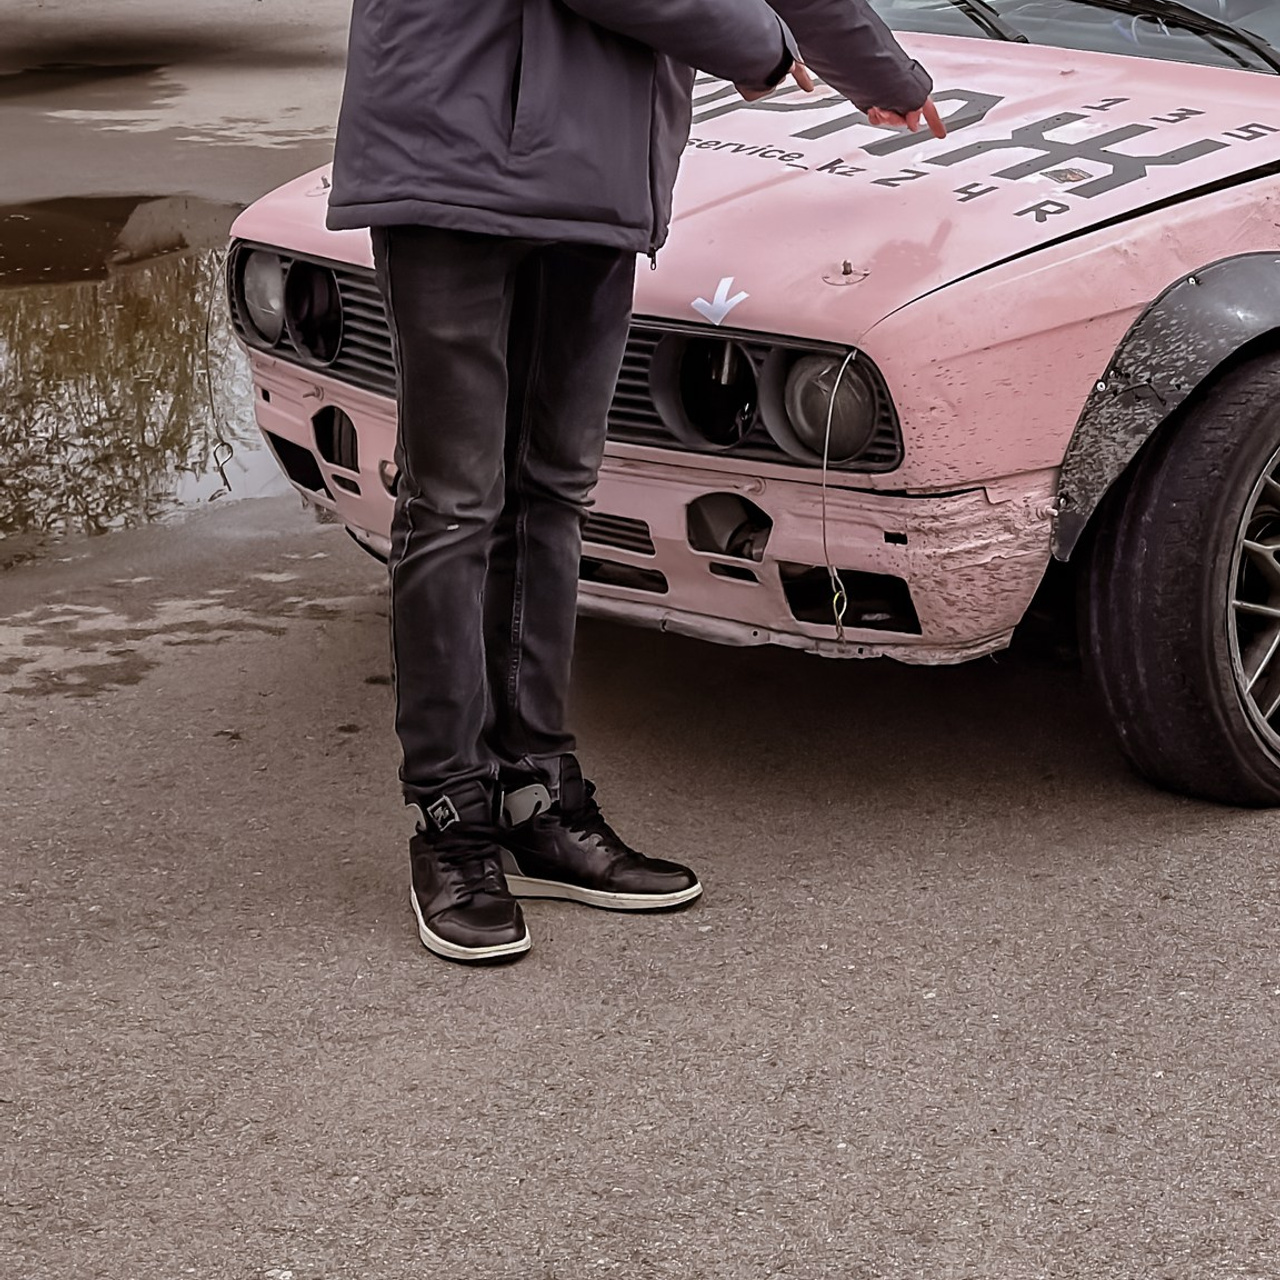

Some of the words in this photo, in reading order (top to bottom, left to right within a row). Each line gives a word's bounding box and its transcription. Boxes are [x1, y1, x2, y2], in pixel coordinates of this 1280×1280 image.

[1083, 98, 1130, 112] 1
[1151, 107, 1206, 124] 3
[1223, 122, 1280, 142] 5
[870, 168, 930, 188] 2
[953, 182, 1000, 203] 4
[1013, 199, 1070, 222] R
